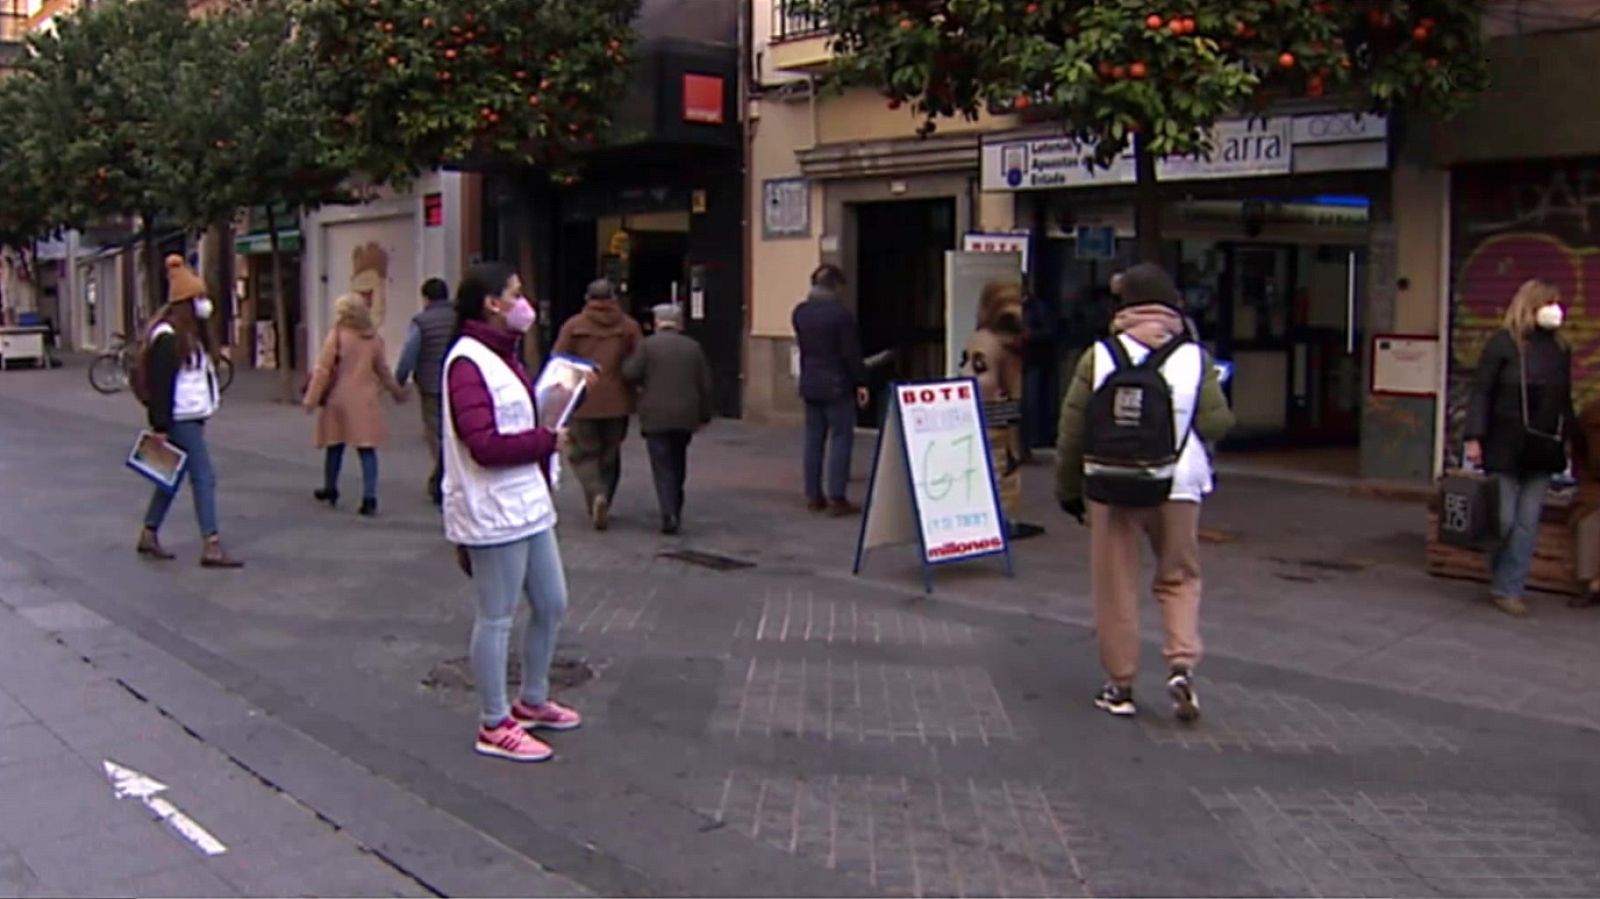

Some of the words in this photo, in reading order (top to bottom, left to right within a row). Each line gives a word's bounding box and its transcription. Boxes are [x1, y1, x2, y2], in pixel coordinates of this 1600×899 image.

[1031, 172, 1065, 185] Estado
[902, 386, 971, 404] BOTE
[928, 537, 1002, 557] millones
